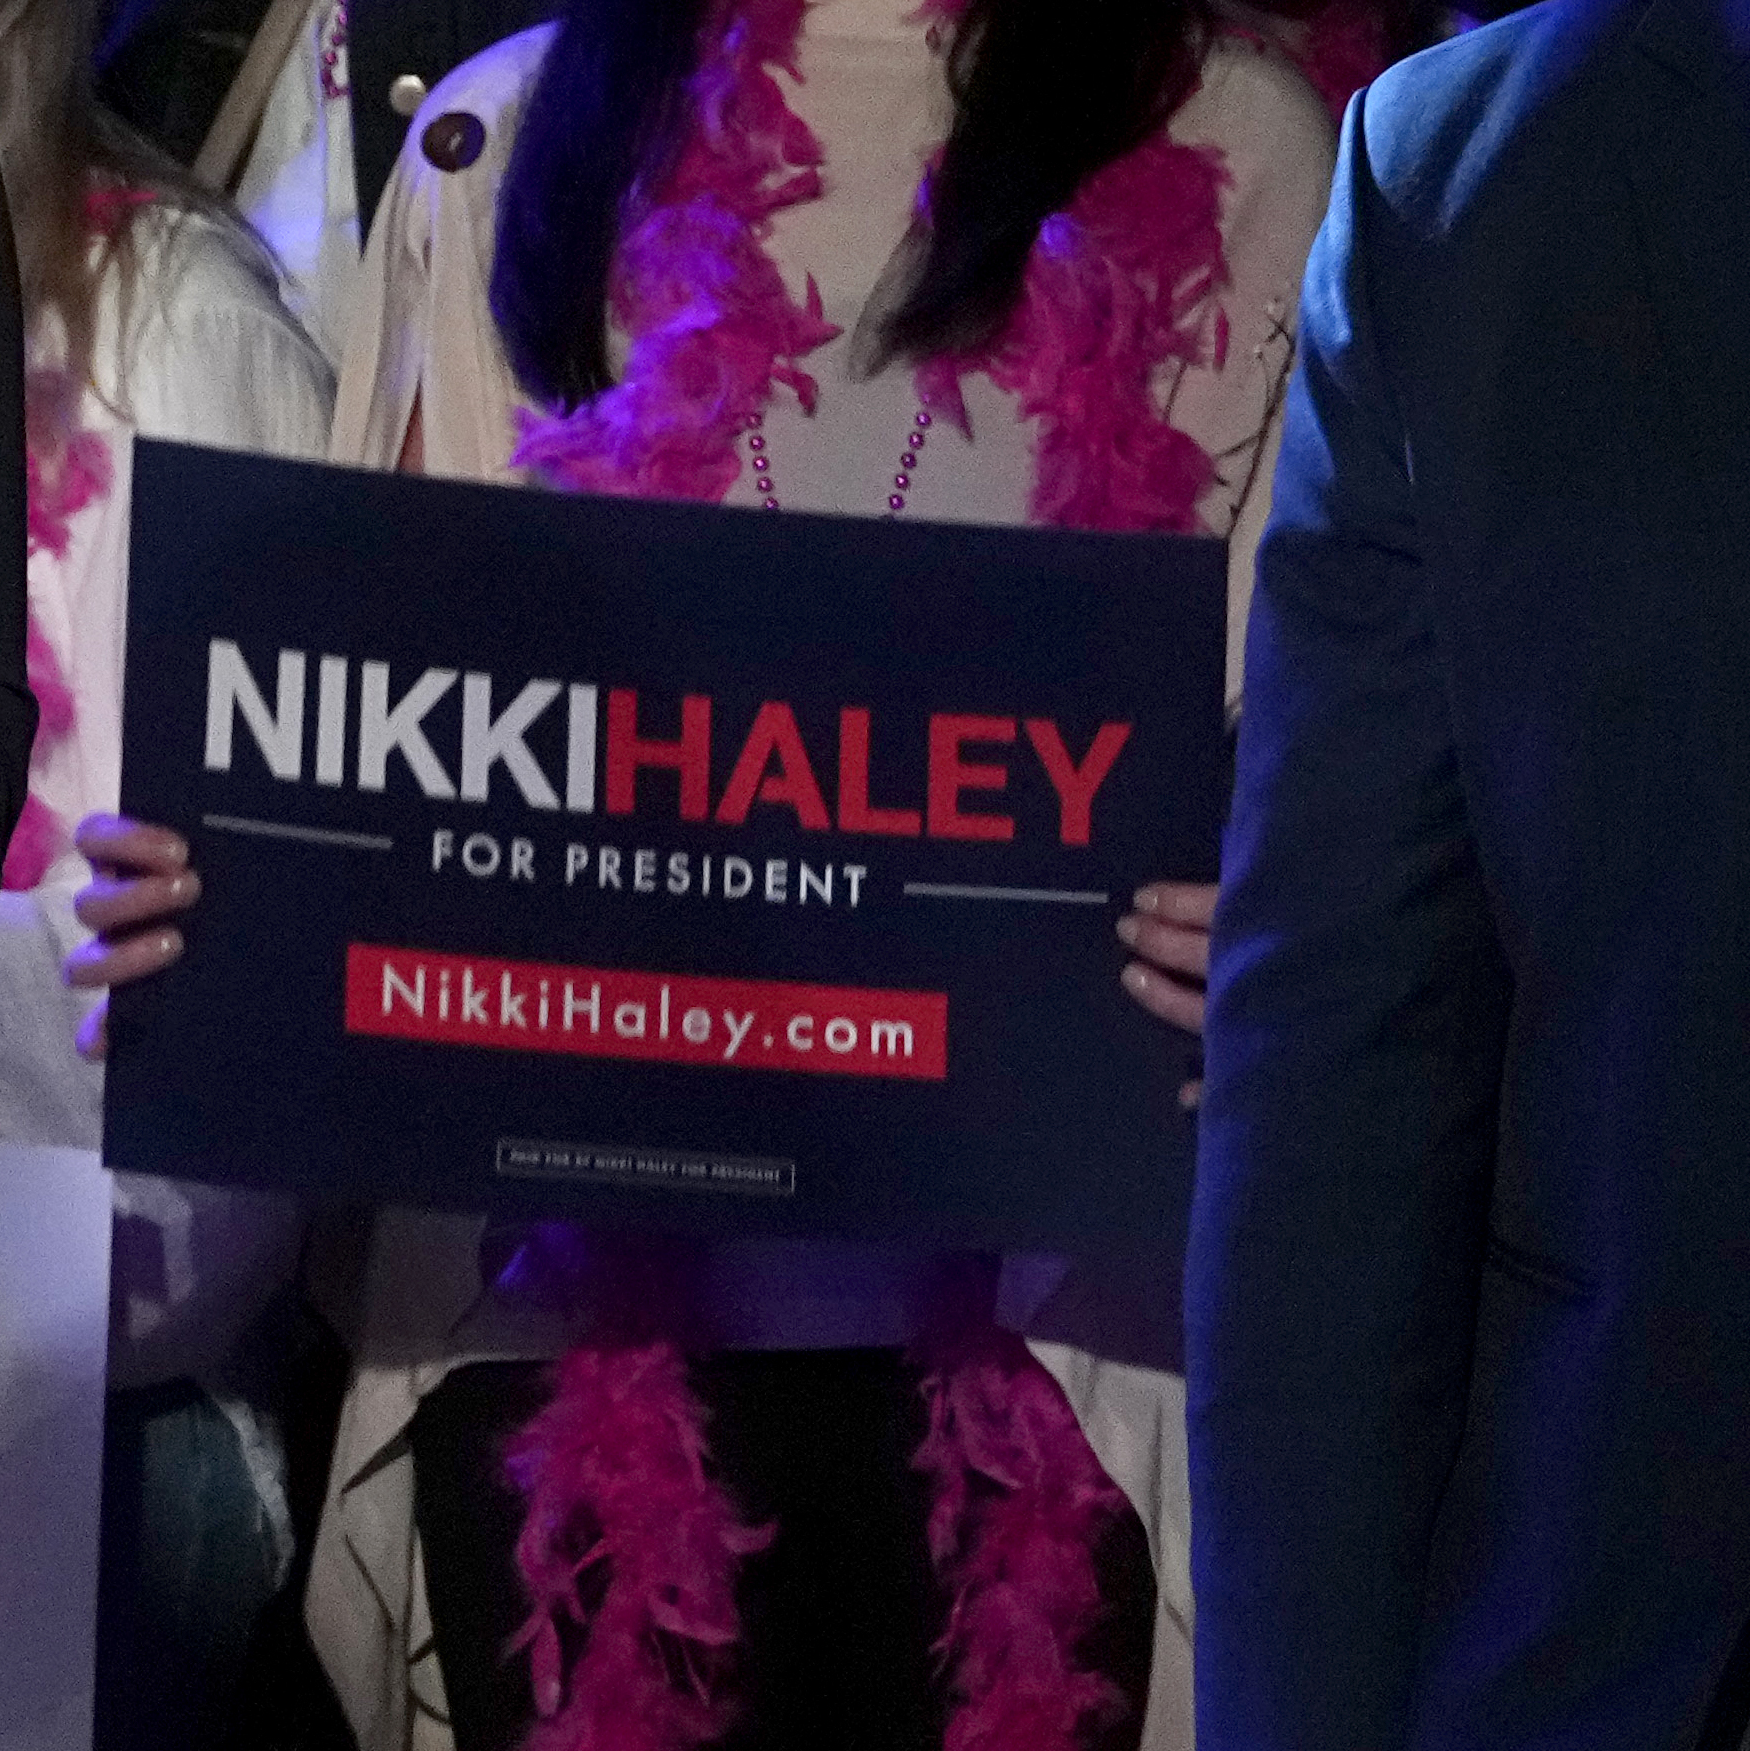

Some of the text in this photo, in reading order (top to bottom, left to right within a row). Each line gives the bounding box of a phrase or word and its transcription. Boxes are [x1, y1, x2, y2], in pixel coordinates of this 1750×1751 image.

[432, 828, 867, 908] FOR PRESIDENT
[381, 963, 914, 1059] NikkiHaley.com
